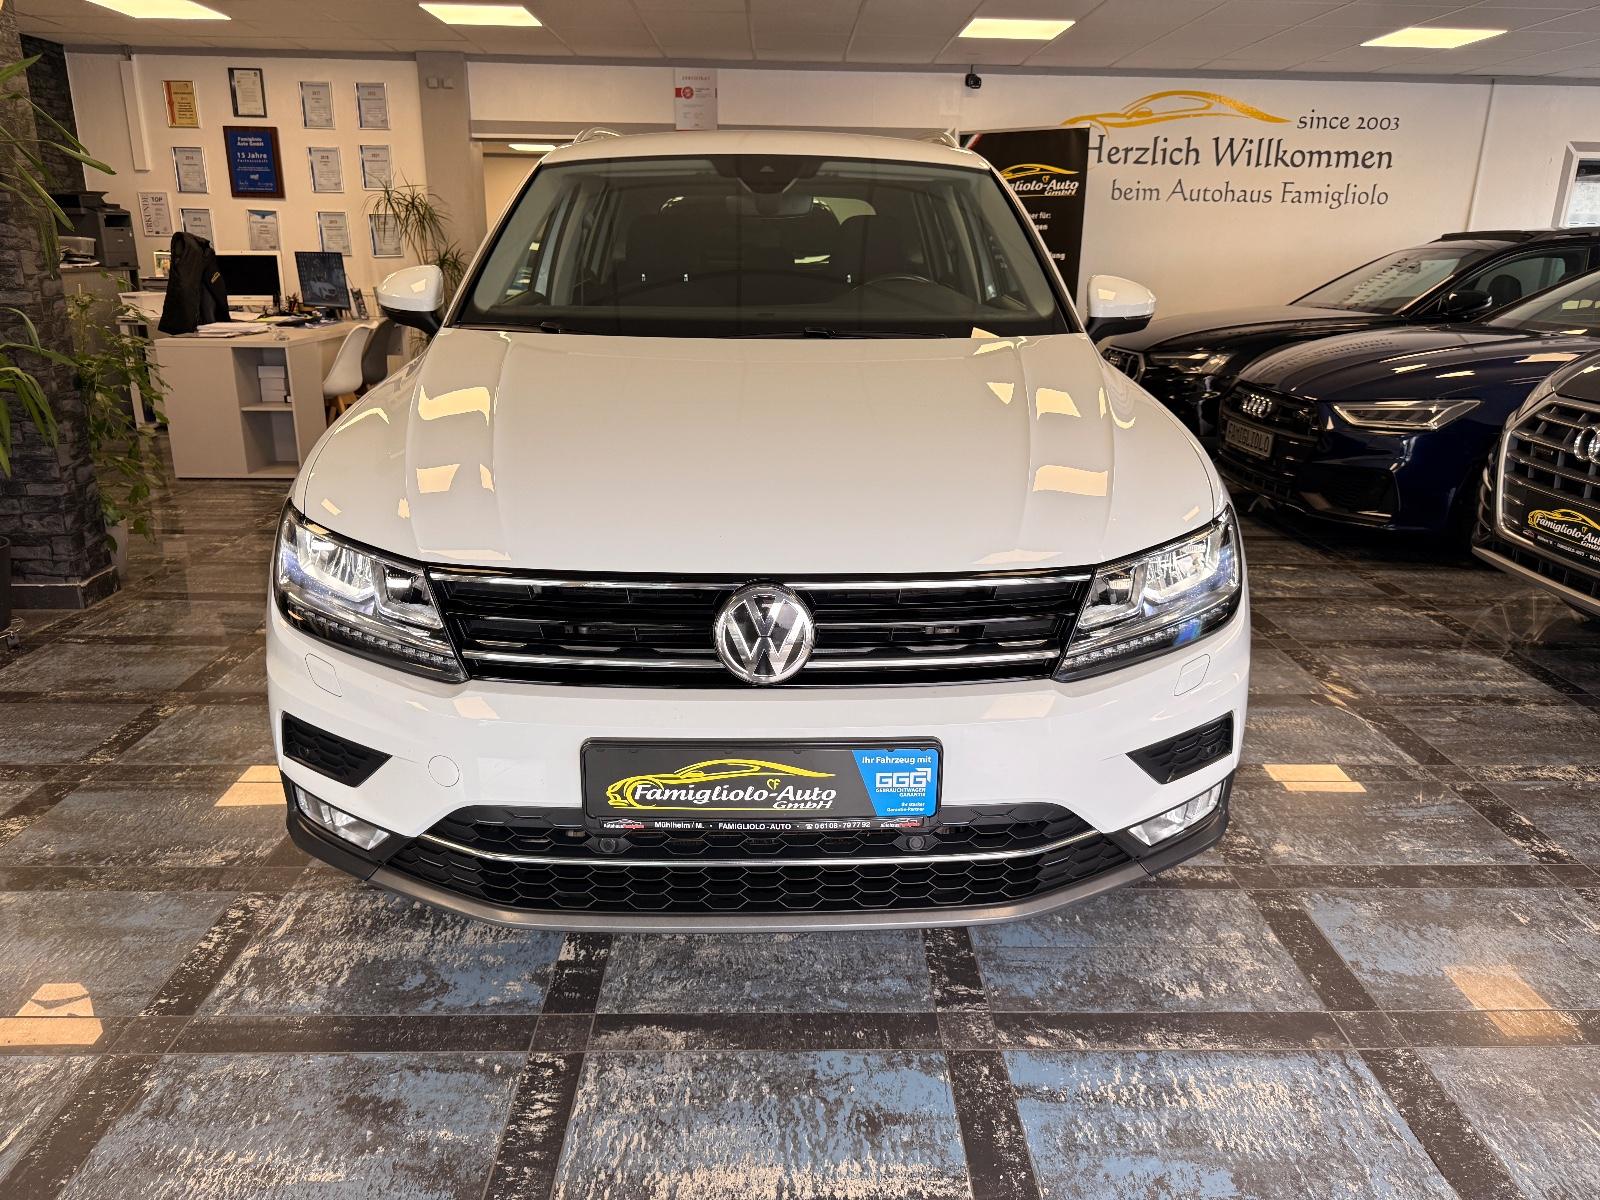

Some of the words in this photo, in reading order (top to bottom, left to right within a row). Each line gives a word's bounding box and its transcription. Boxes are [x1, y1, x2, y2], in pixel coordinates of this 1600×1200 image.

[1296, 109, 1351, 130] since
[1355, 116, 1400, 131] 2003
[1087, 134, 1201, 166] Herzlich
[1212, 137, 1394, 169] Willkommen
[1044, 189, 1078, 197] GmbH
[1110, 179, 1161, 202] beim
[1166, 179, 1273, 204] Autohaus
[1280, 181, 1390, 210] Famigliolo
[862, 756, 875, 764] Ihr
[875, 756, 916, 765] Fahrzeug
[917, 755, 932, 763] mit
[875, 772, 927, 788] GGG
[634, 784, 837, 805] Famigliolo-Auto
[772, 800, 833, 810] GmbH
[654, 821, 690, 829] Mühlheim
